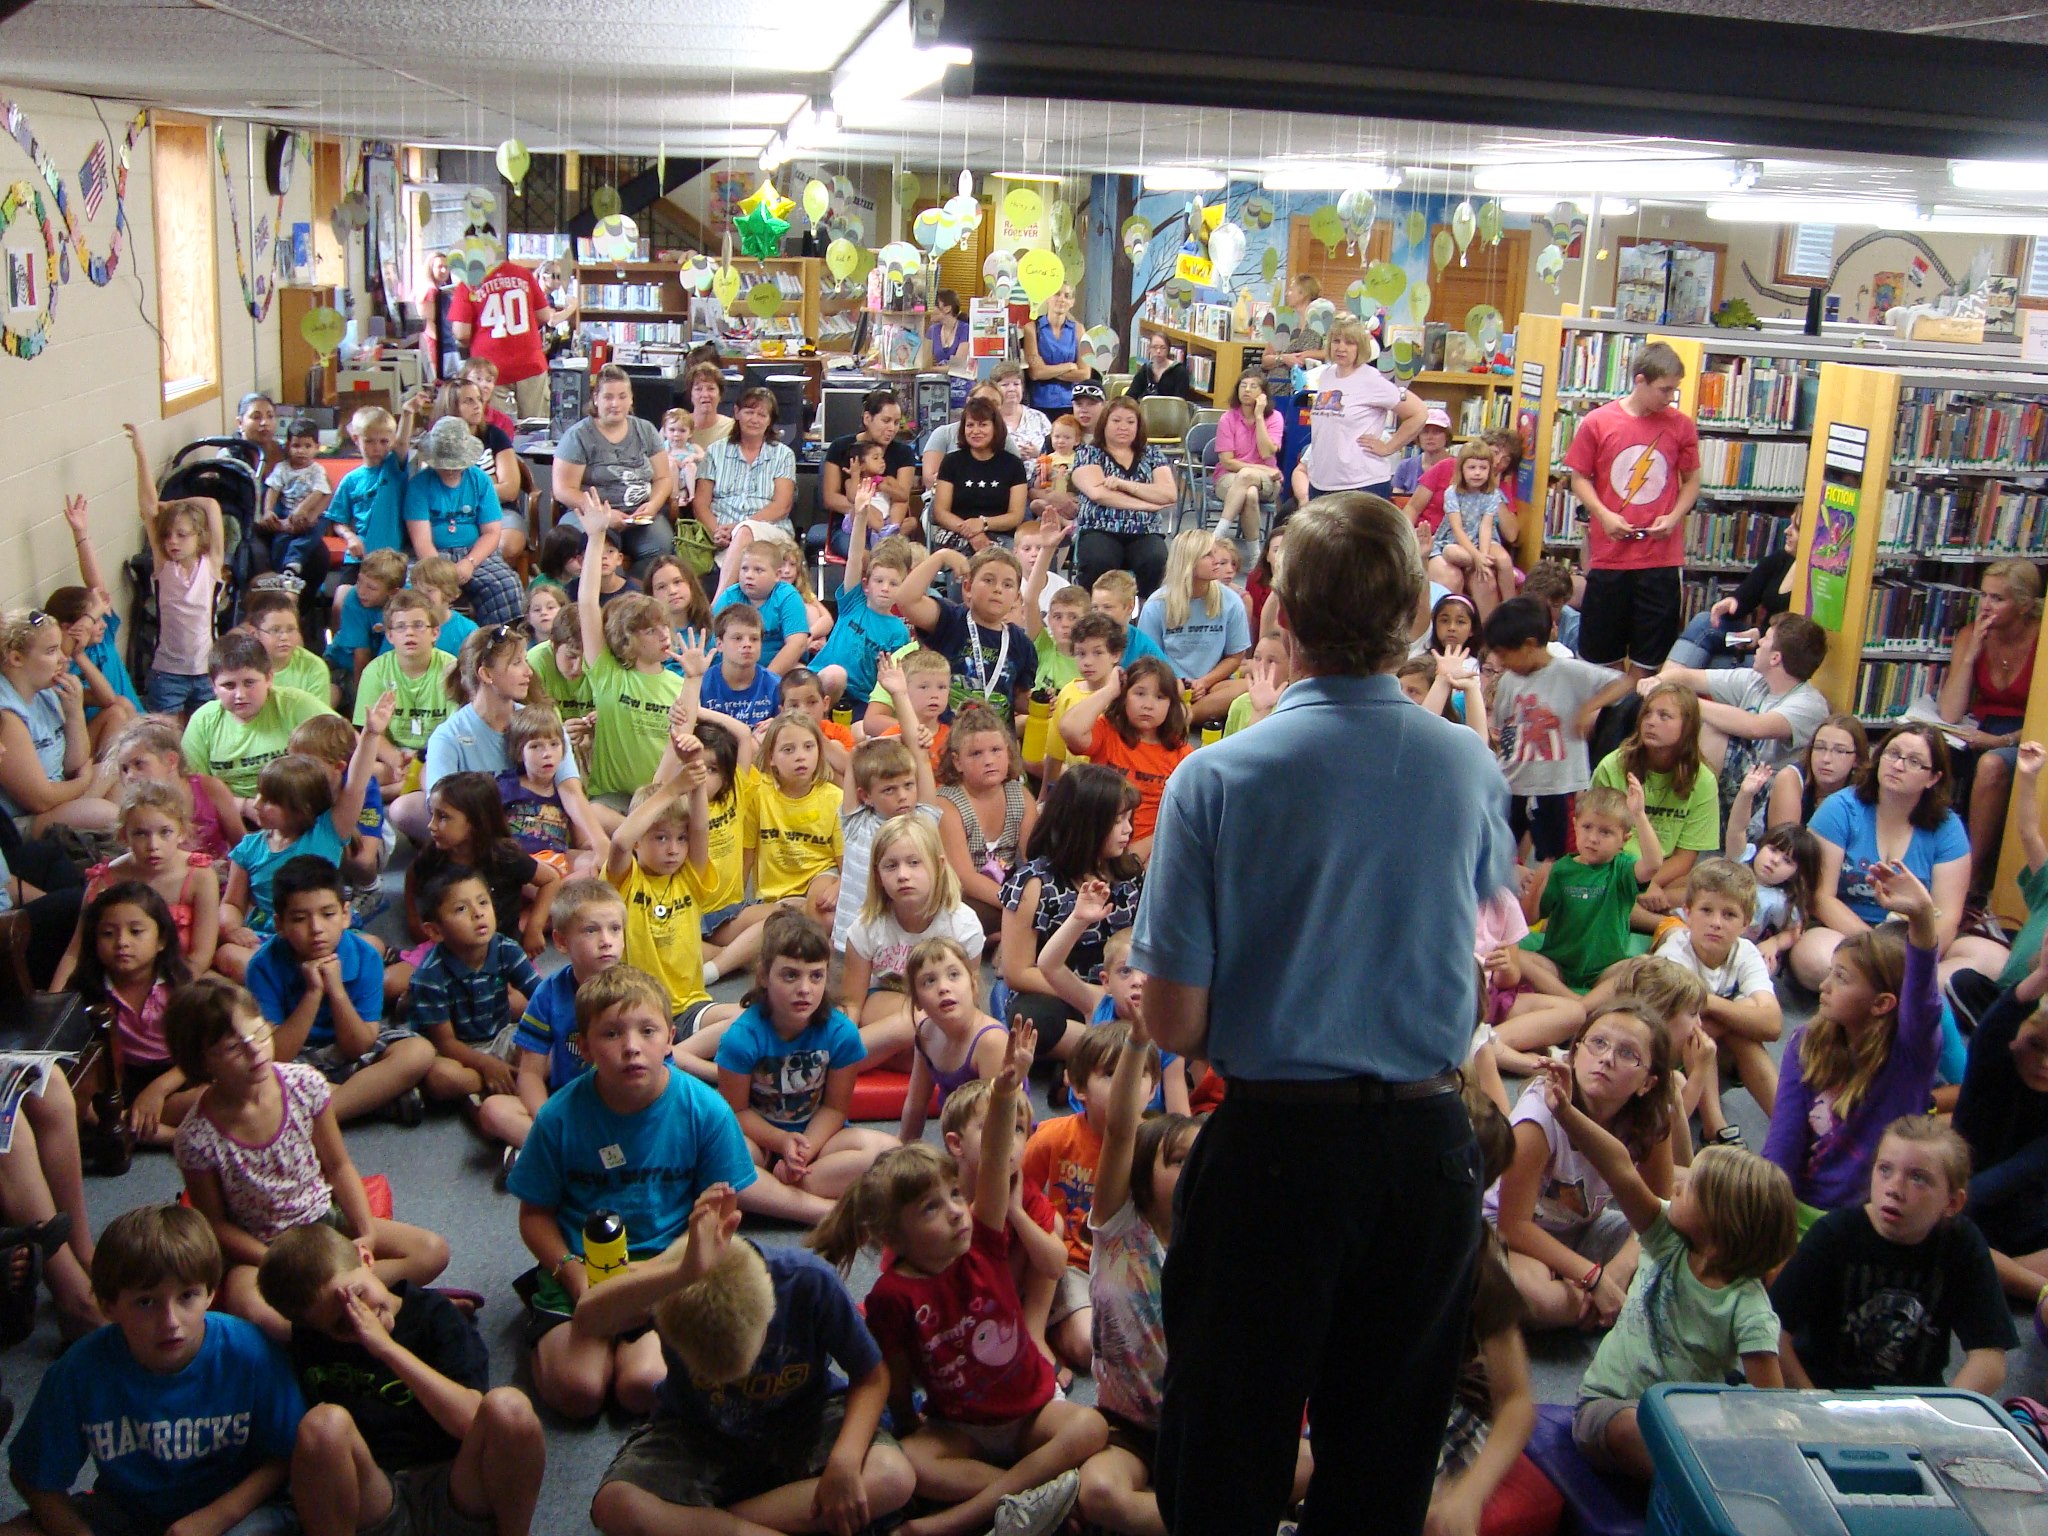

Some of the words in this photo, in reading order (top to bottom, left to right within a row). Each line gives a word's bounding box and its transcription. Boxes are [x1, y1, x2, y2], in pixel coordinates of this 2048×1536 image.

[481, 288, 530, 338] 40
[1826, 488, 1857, 507] FICTION
[724, 700, 753, 713] pretty
